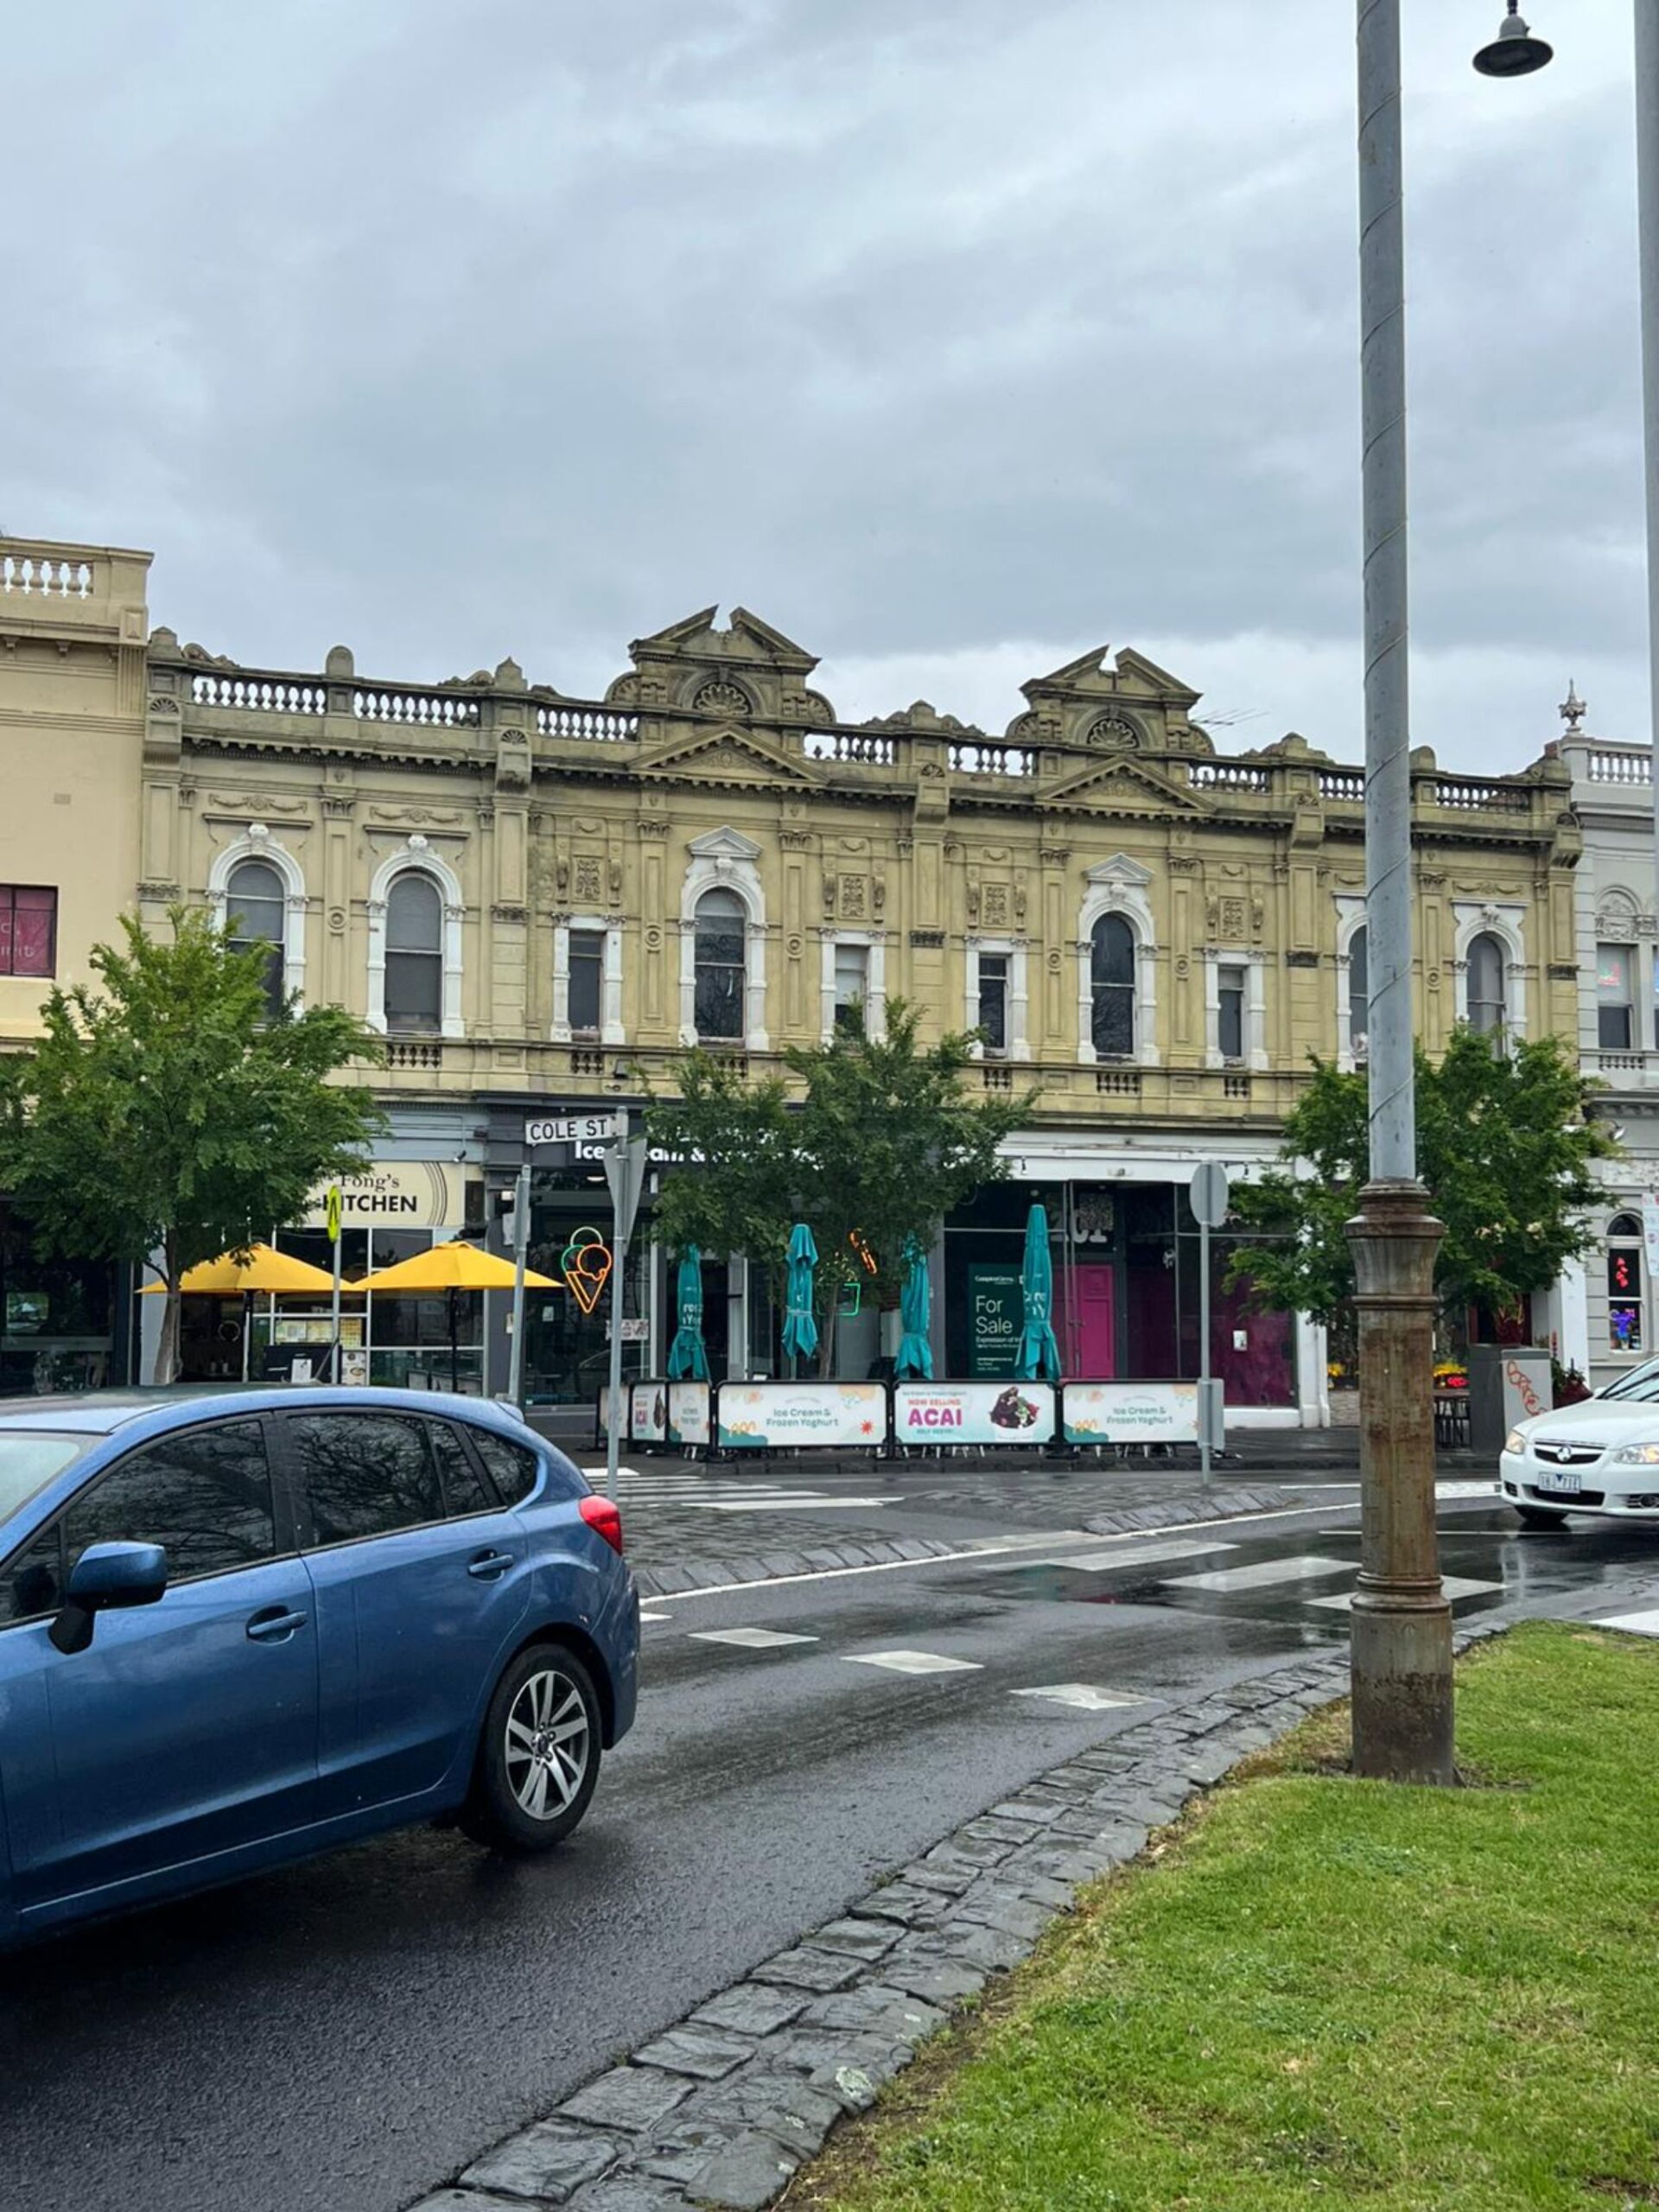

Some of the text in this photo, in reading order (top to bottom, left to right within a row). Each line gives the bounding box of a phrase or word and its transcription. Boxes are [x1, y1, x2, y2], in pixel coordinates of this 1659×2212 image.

[530, 1119, 607, 1141] COLE ST
[575, 1141, 605, 1160] Ice
[976, 1295, 1003, 1313] For
[976, 1316, 1013, 1334] Sale
[773, 1408, 788, 1417] Ice
[790, 1408, 822, 1417] Cream
[908, 1408, 962, 1426] ACAI
[800, 1418, 839, 1429] Yoghurt
